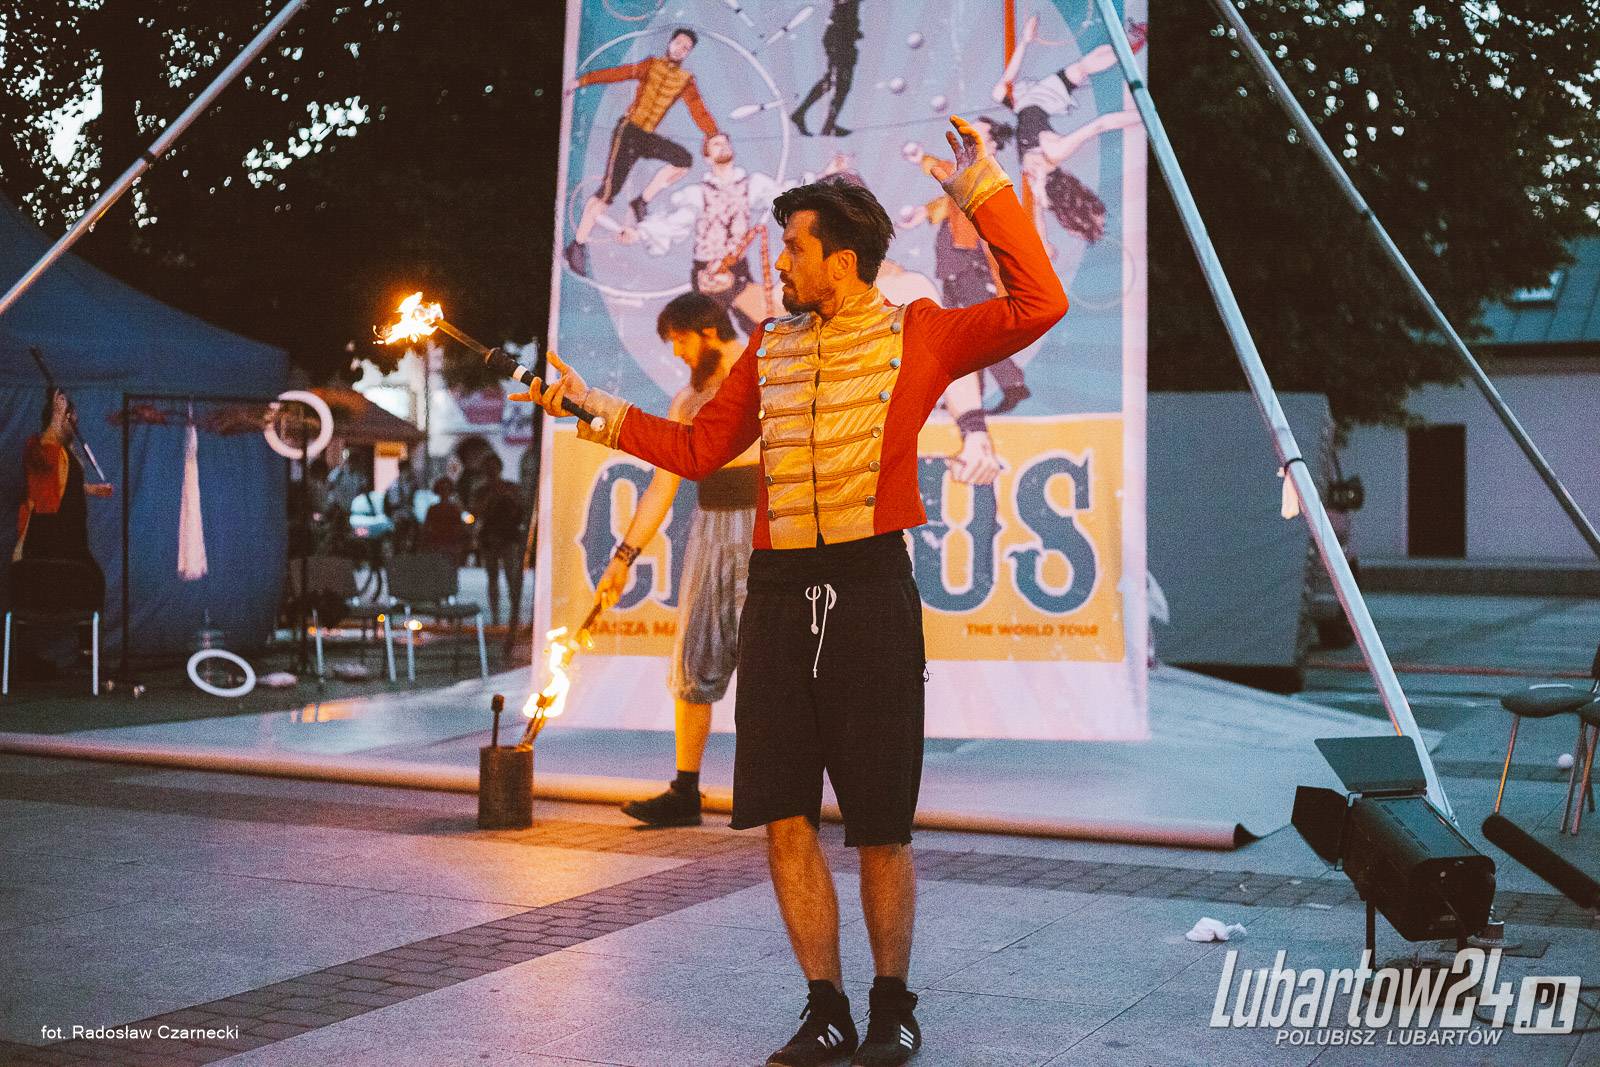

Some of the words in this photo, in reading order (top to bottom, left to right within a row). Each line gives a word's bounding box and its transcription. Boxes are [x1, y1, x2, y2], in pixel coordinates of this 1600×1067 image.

[967, 623, 993, 636] THE
[997, 623, 1054, 636] WORLD
[1058, 623, 1099, 636] TOUR
